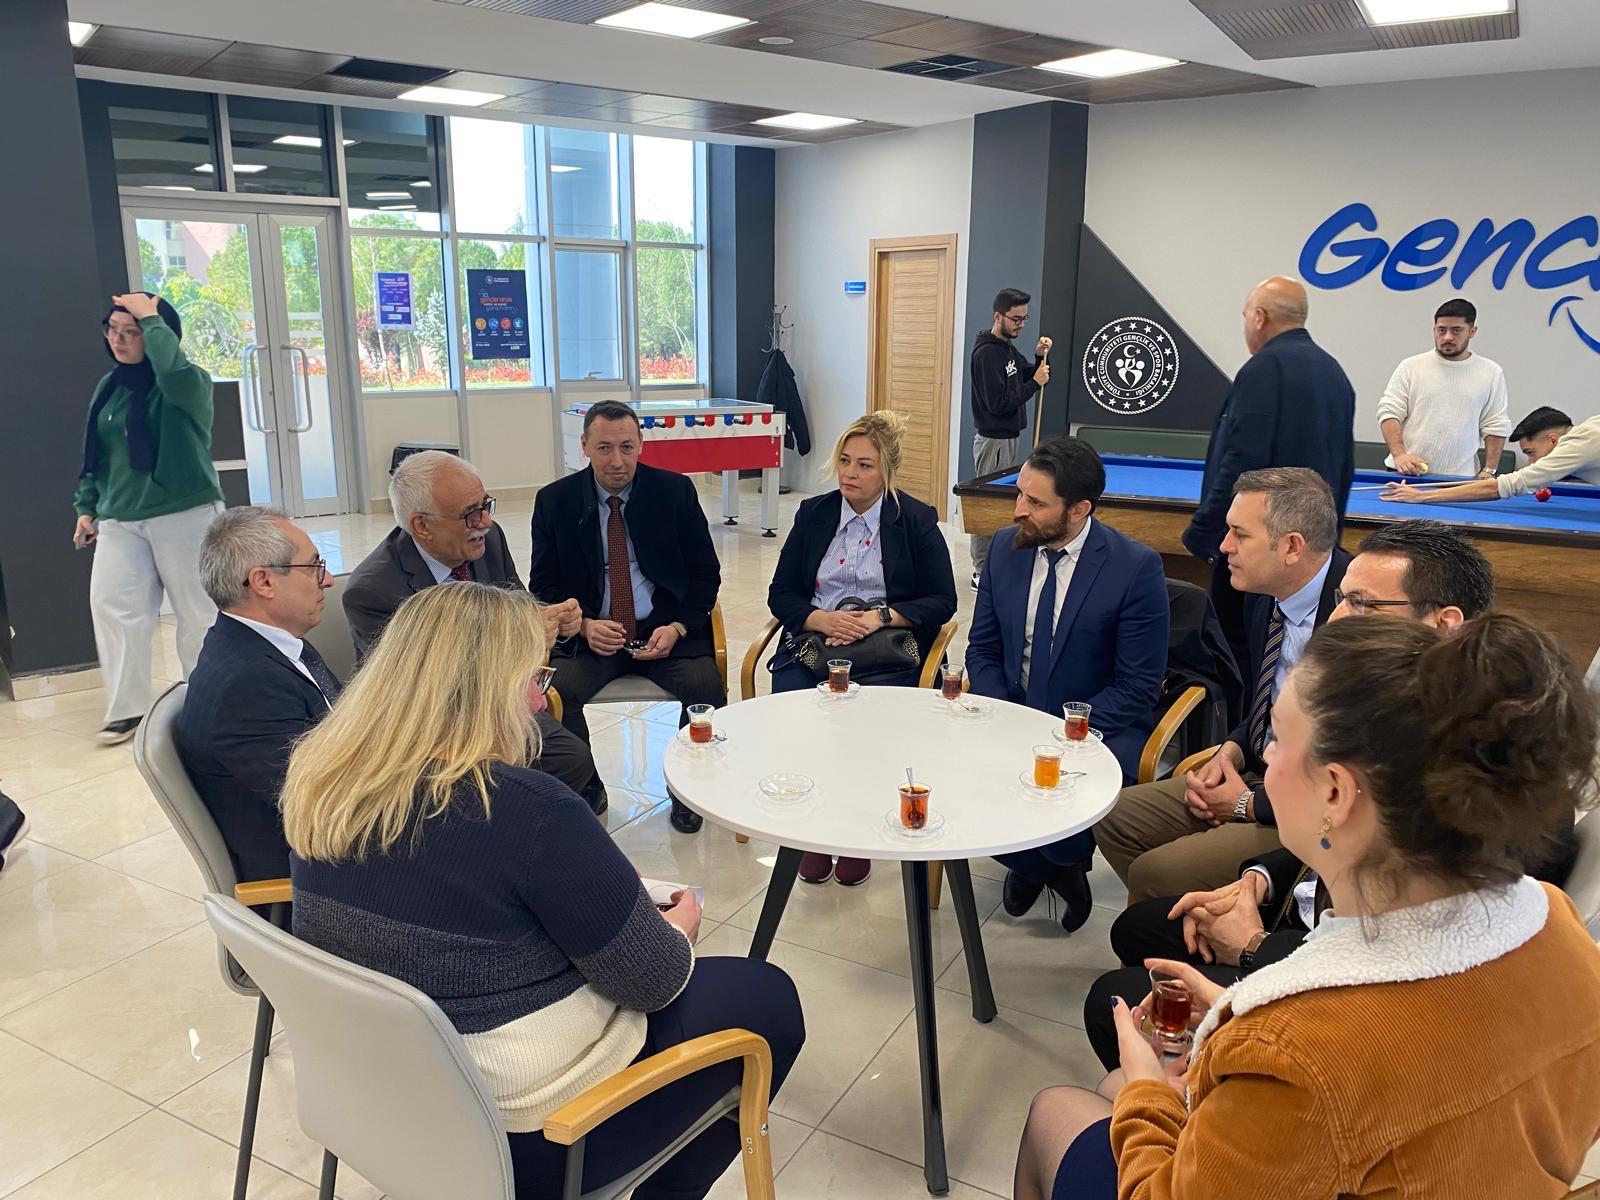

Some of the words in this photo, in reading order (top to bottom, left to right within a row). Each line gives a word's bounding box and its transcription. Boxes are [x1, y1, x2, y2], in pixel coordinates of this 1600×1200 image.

[1123, 335, 1149, 345] GENÇLİK
[1149, 342, 1156, 351] VE
[1099, 337, 1122, 375] CUMHURİYETİ
[1153, 350, 1161, 368] SPOR
[1100, 374, 1121, 396] TÜRKİYE
[1135, 369, 1160, 396] BAKANLIĞI
